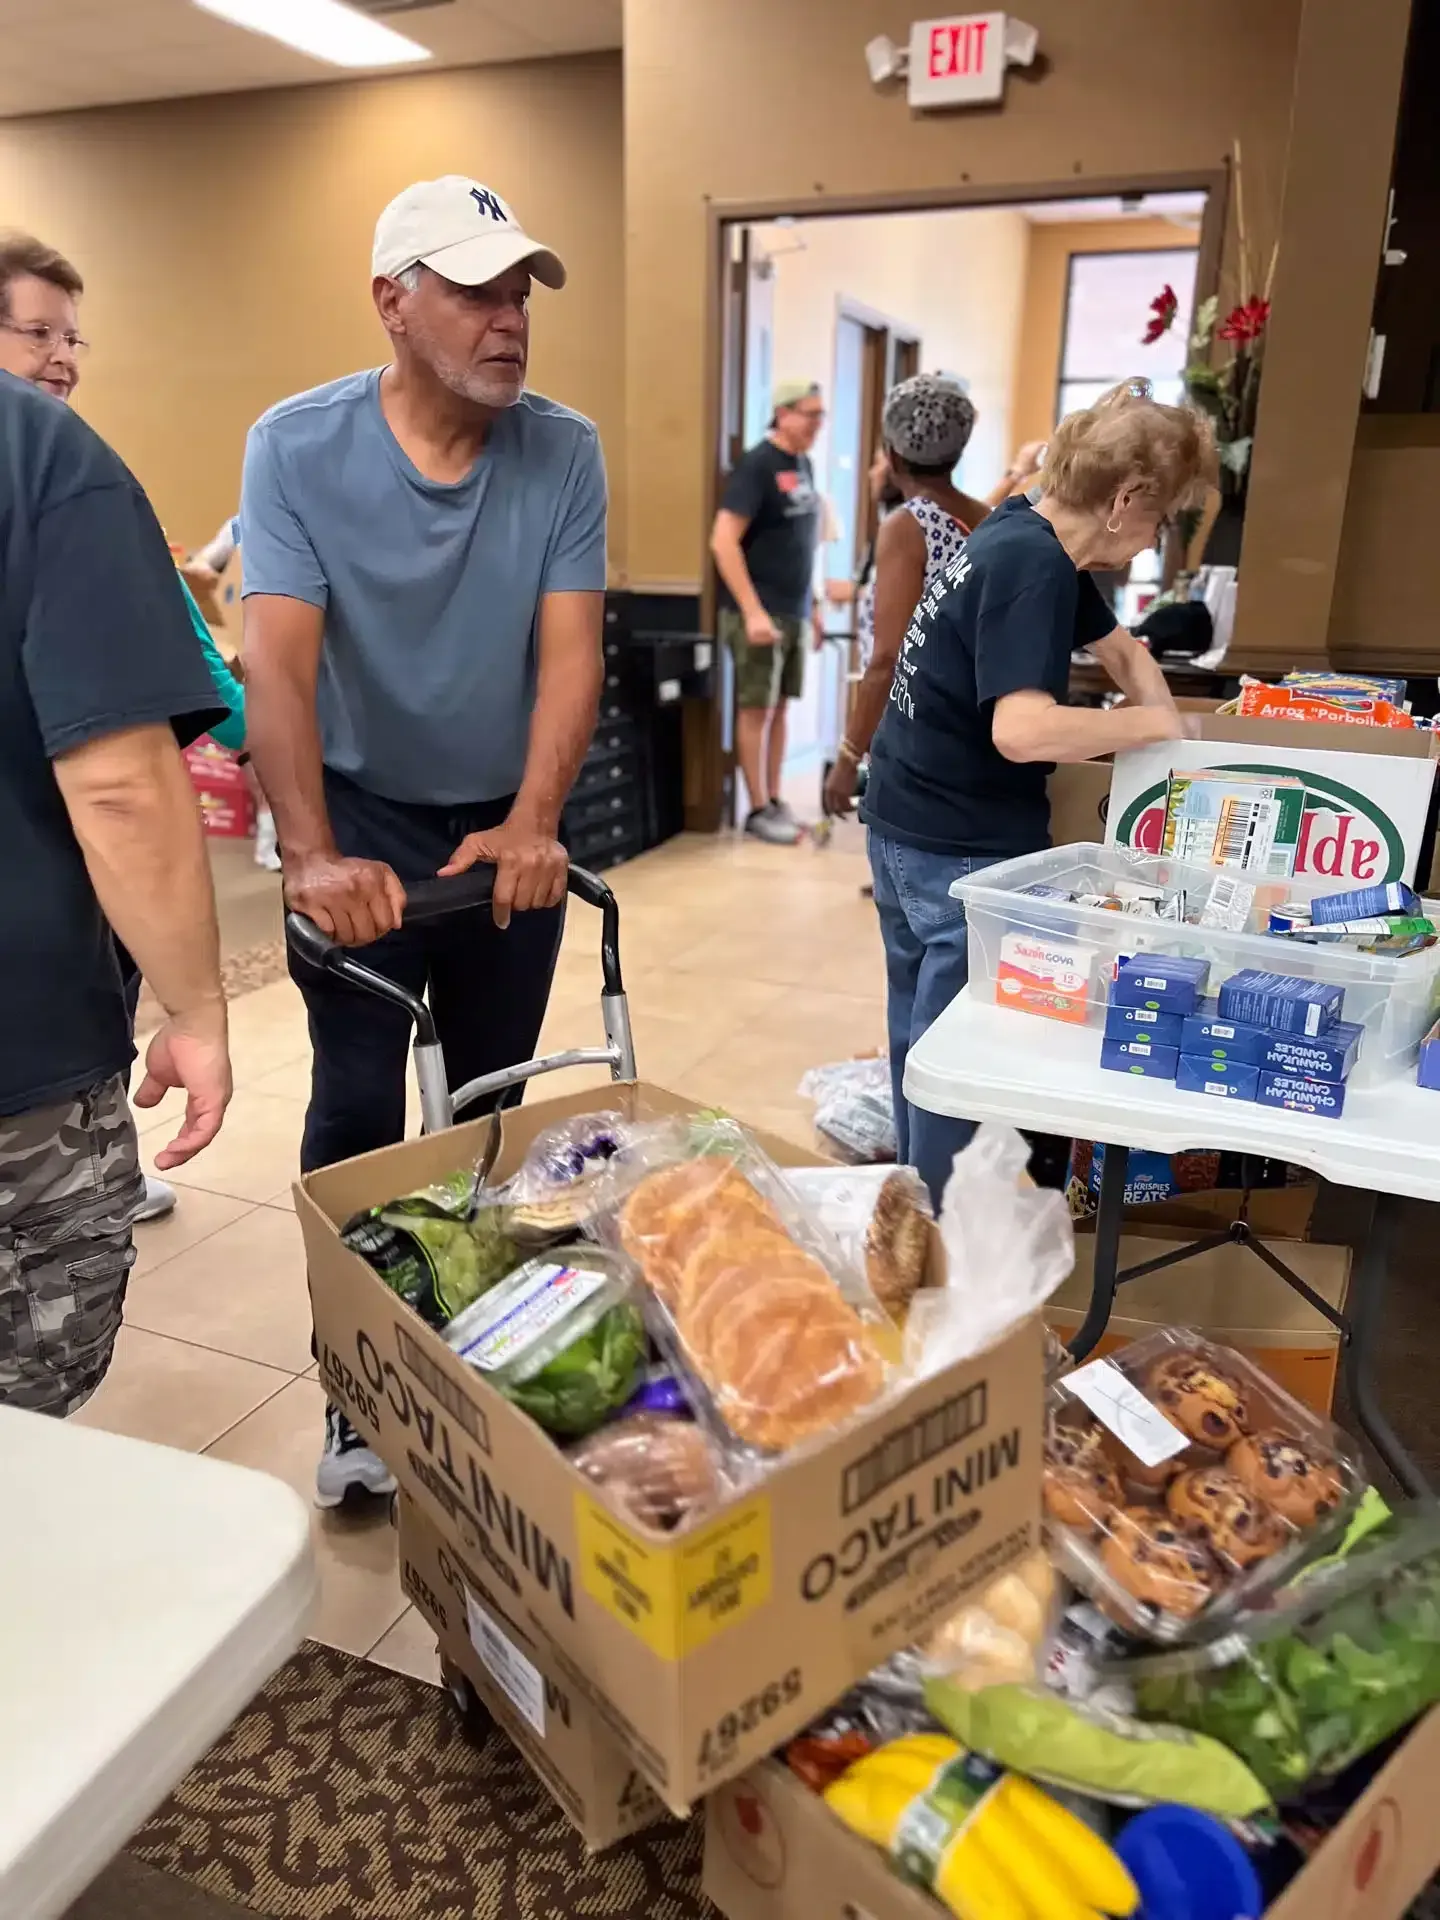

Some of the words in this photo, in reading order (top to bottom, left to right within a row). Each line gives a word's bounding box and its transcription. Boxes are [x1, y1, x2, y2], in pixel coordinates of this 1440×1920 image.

[929, 22, 989, 79] EXIT
[469, 187, 507, 222] NY
[907, 623, 926, 648] 2010
[1045, 953, 1074, 966] GOYA
[1063, 974, 1074, 985] 12
[1266, 1051, 1333, 1072] CHANUKAH
[1274, 1042, 1328, 1061] CANDLES
[1265, 1086, 1336, 1107] CHANUKAH
[1273, 1077, 1331, 1096] CANDLES
[1122, 1191, 1168, 1204] REATS
[1133, 1182, 1170, 1191] KRISPIES
[323, 1342, 381, 1434] 59267
[356, 1328, 465, 1493] TACO
[933, 1427, 1020, 1515] MINI
[468, 1452, 575, 1622] MINI
[801, 1491, 925, 1603] TACO
[404, 1559, 448, 1631] 59267
[697, 1666, 803, 1769] 59267
